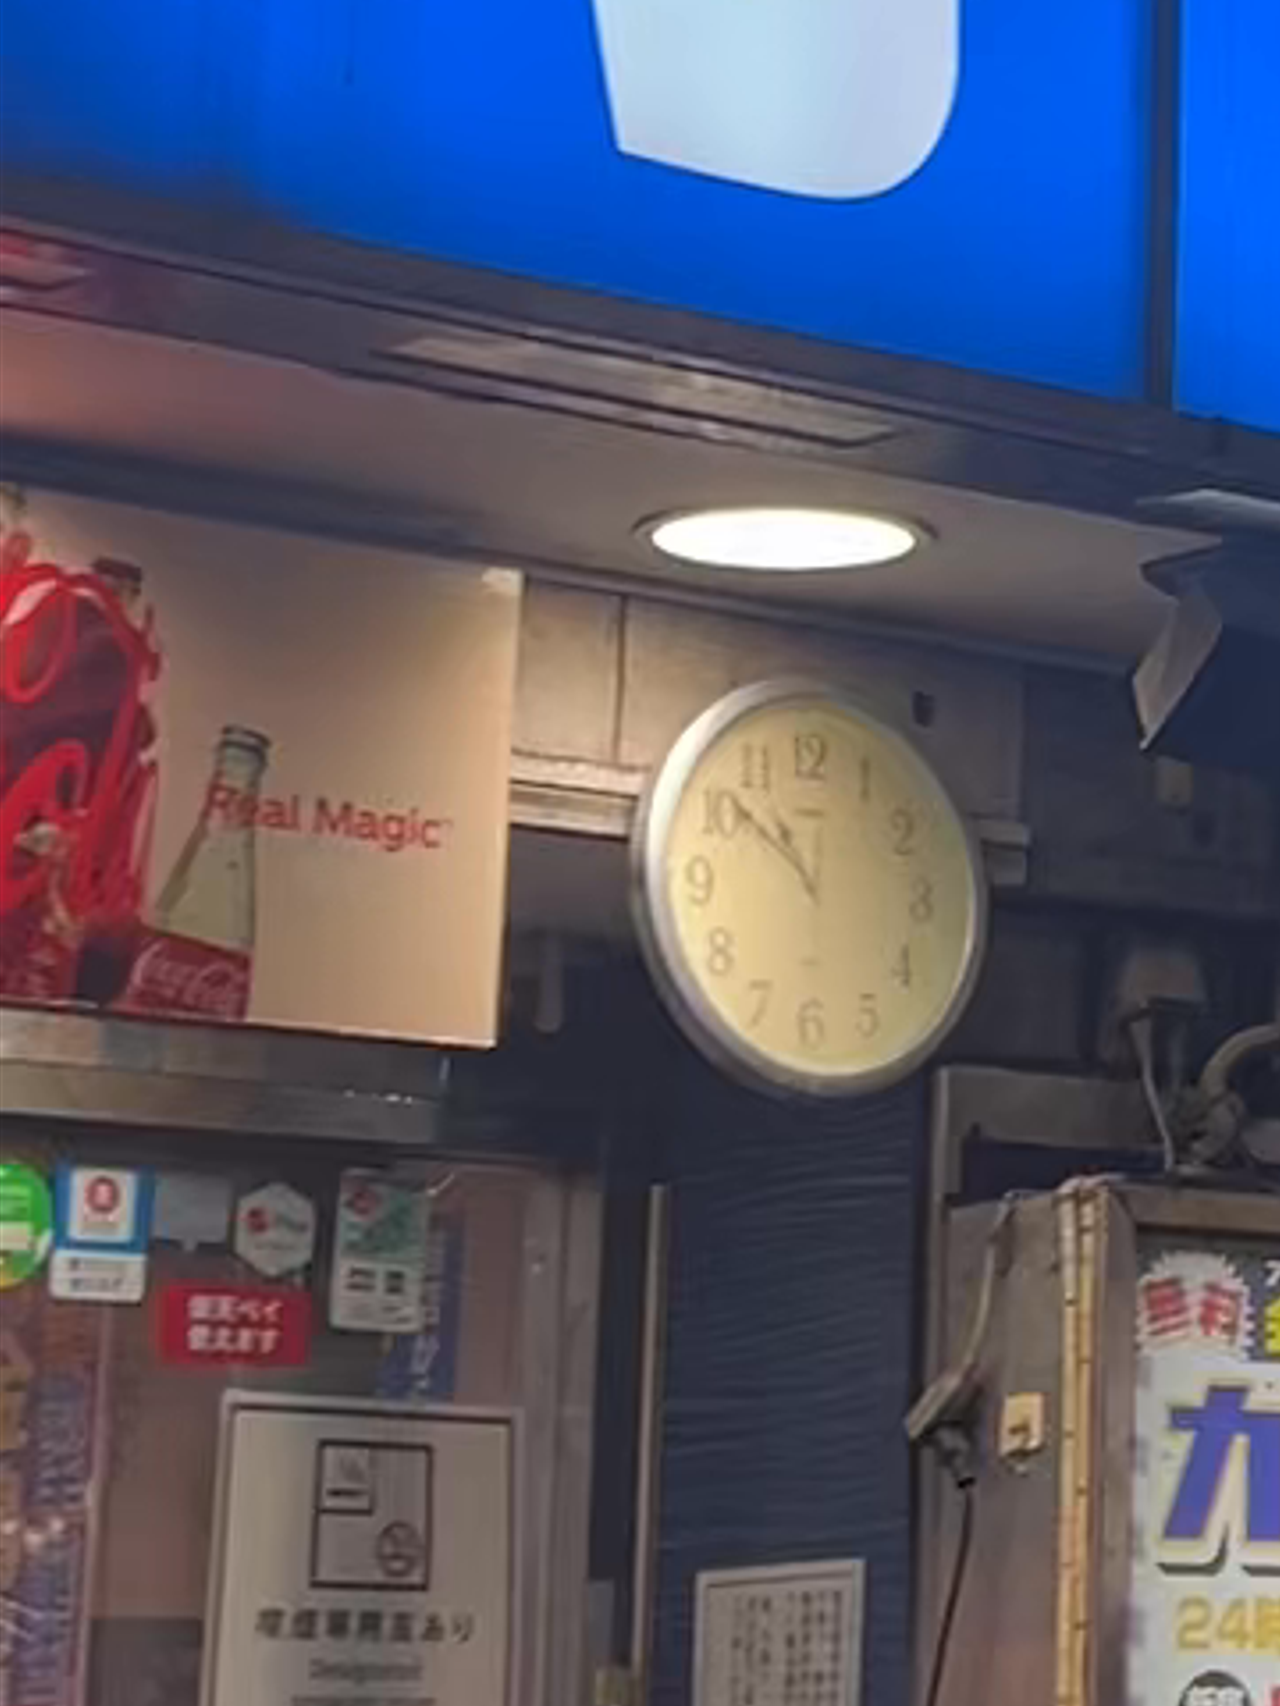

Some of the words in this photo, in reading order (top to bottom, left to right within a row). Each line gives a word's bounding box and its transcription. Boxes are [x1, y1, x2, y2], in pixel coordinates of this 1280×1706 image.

[741, 743, 770, 791] 11
[794, 732, 829, 781] 12
[859, 755, 872, 803] 1
[204, 783, 301, 834] Real
[312, 797, 443, 852] Magic
[703, 789, 741, 839] 10
[891, 808, 915, 857] 2
[685, 854, 715, 907] 9
[909, 878, 933, 923] 3
[706, 926, 735, 977] 8
[891, 943, 912, 988] 4
[749, 979, 773, 1028] 7
[797, 997, 826, 1050] 6
[856, 992, 880, 1040] 5
